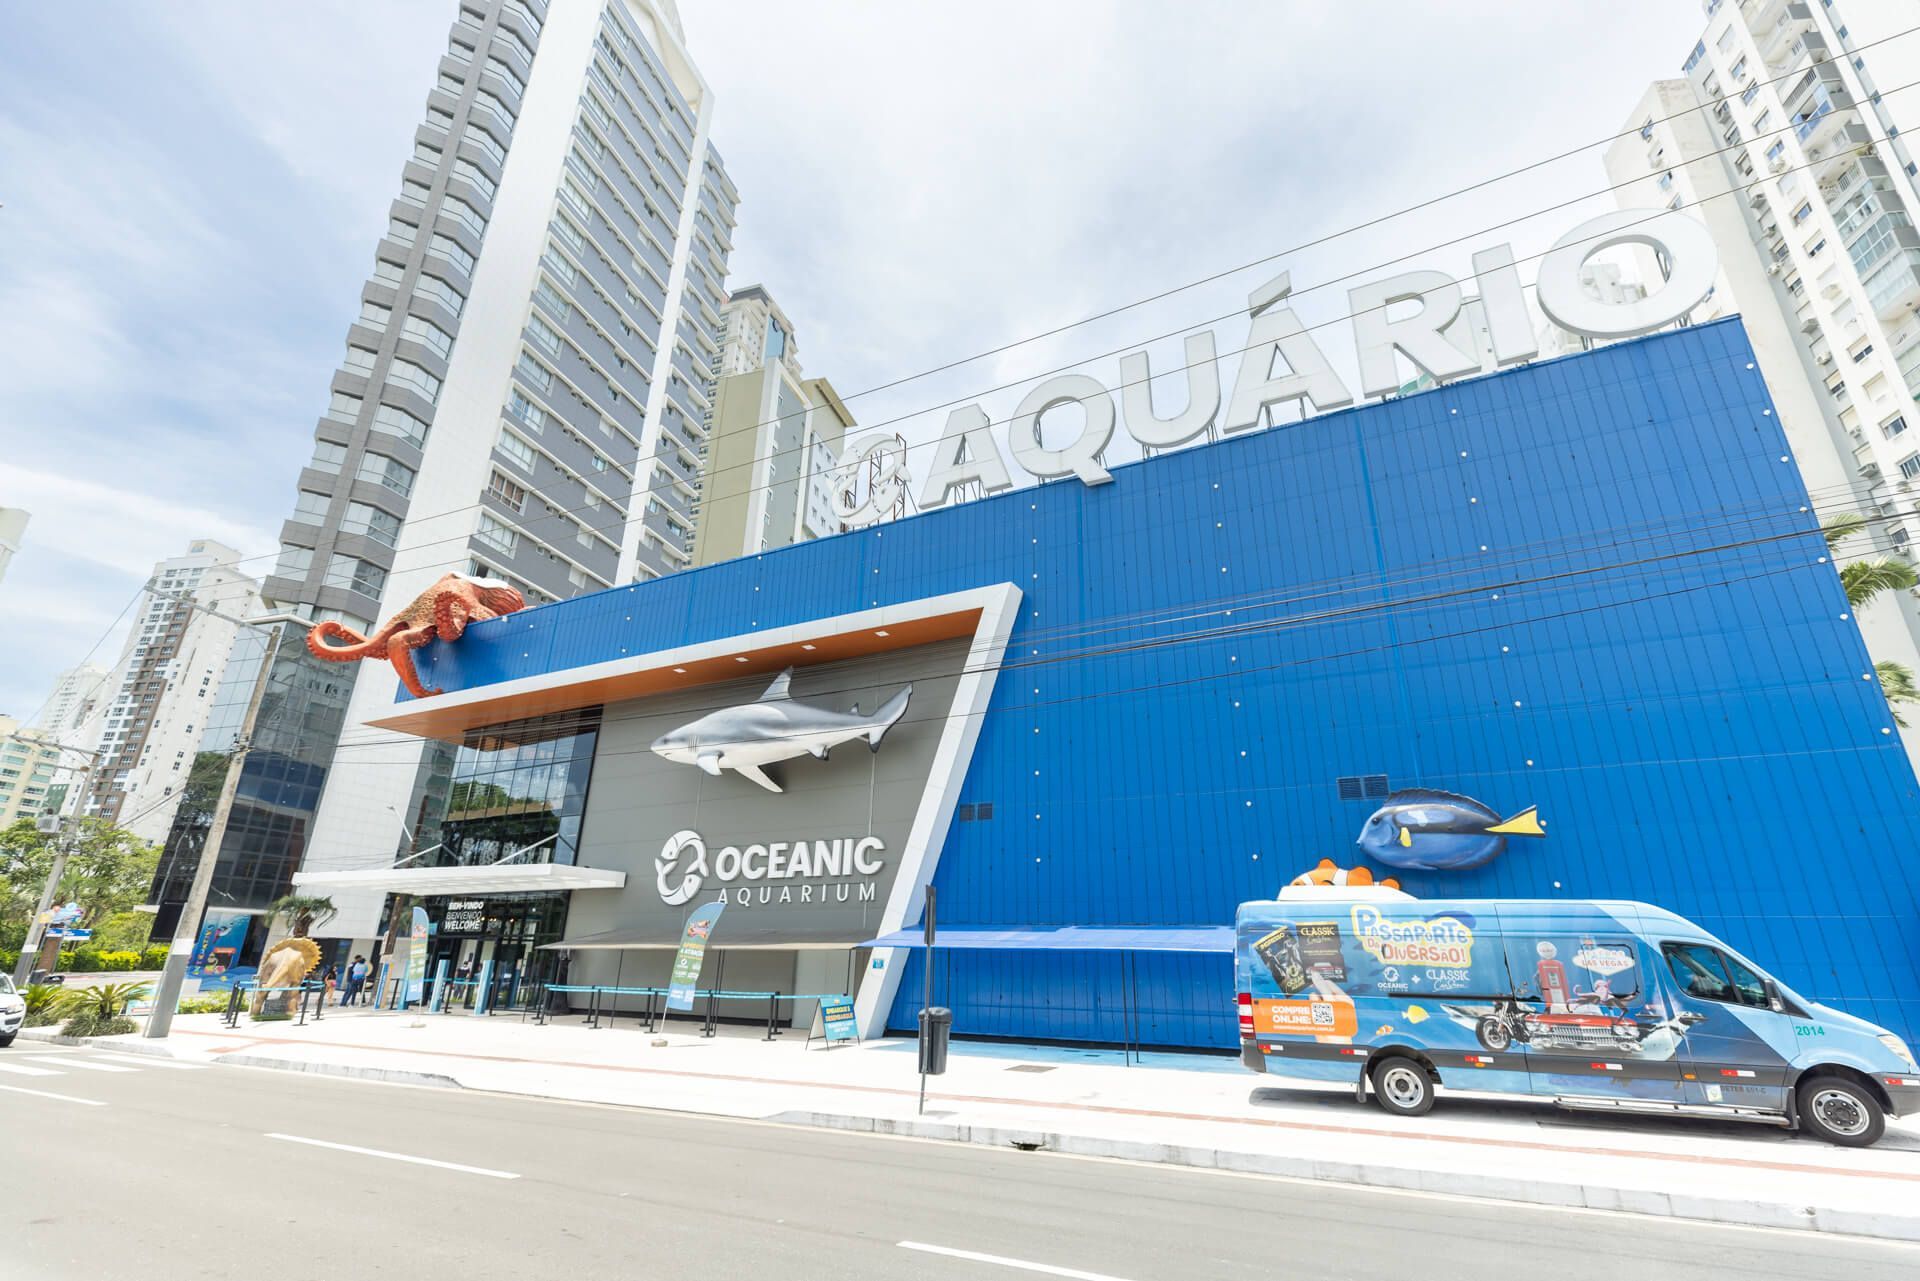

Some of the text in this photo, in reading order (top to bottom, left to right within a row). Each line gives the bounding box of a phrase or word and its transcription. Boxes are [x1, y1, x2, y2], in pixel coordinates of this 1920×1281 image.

[918, 207, 1719, 510] AQUÁRIO
[715, 836, 885, 881] OCEANIC
[718, 882, 877, 907] AQUARIUM
[444, 919, 481, 930] WELCOME
[1300, 927, 1335, 936] CLASSIC
[1582, 959, 1629, 967] LAS VEGAS
[1426, 969, 1471, 981] CLASSIC
[1271, 1005, 1310, 1014] COMPRE
[1795, 1025, 1825, 1036] 2014
